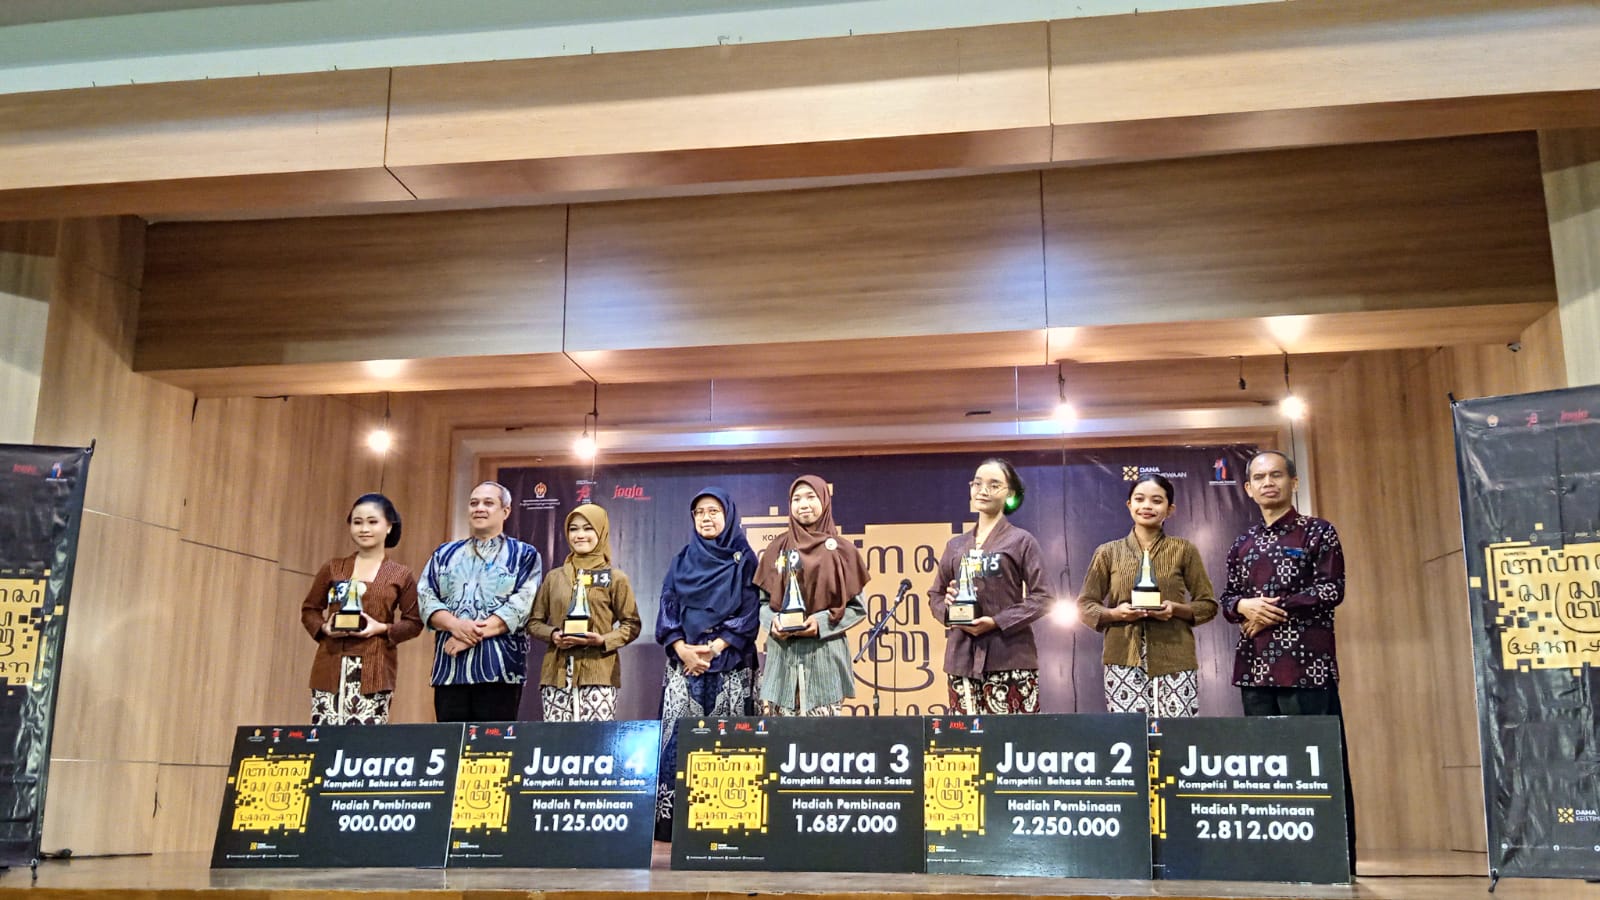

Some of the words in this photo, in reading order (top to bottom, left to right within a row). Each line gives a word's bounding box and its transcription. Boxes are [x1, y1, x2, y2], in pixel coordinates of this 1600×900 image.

[983, 553, 1000, 571] 15
[593, 573, 609, 583] 13
[326, 749, 414, 776] Juara
[426, 749, 446, 775] 5
[524, 747, 613, 776] Juara
[625, 747, 647, 774] 4
[780, 743, 875, 773] Juara
[890, 744, 910, 773] 3
[996, 742, 1095, 773] Juara
[1110, 742, 1132, 773] 2
[1180, 745, 1288, 777] Juara
[1306, 746, 1320, 776] 1
[323, 780, 364, 789] Kompetisi
[369, 779, 398, 787] Bahasa
[401, 779, 416, 787] dan
[523, 778, 563, 788] Kompetisi
[569, 778, 599, 786] Bahasa
[601, 778, 617, 786] dan
[620, 778, 646, 786] Sastra
[780, 776, 824, 786] Kompetisi
[829, 776, 862, 785] Bahasa
[864, 776, 881, 785] dan
[884, 776, 912, 785] Sastra
[997, 776, 1042, 787] Kompetisi
[1047, 776, 1081, 785] Bahasa
[1084, 777, 1102, 785] dan
[1105, 777, 1135, 786] Sastra
[1179, 780, 1227, 791] Kompetisi
[1233, 780, 1270, 789] Bahasa
[1273, 780, 1293, 789] dan
[1296, 780, 1328, 789] Sastra
[332, 800, 369, 810] Hadiah
[373, 800, 431, 809] Pembinaan
[533, 799, 570, 809] Hadiah
[574, 799, 633, 809] Pembinaan
[793, 798, 833, 809] Hadiah
[837, 799, 900, 810] Pembinaan
[1008, 800, 1050, 811] Hadiah
[1054, 800, 1121, 812] Pembinaan
[1191, 803, 1237, 815] Hadiah
[1241, 804, 1314, 816] Pembinaan
[339, 814, 415, 831] 900.000
[535, 814, 628, 831] 1.125.000
[796, 815, 897, 833] 1.687.000
[1012, 817, 1120, 837] 2.250.000
[1197, 820, 1313, 841] 2.812.000
